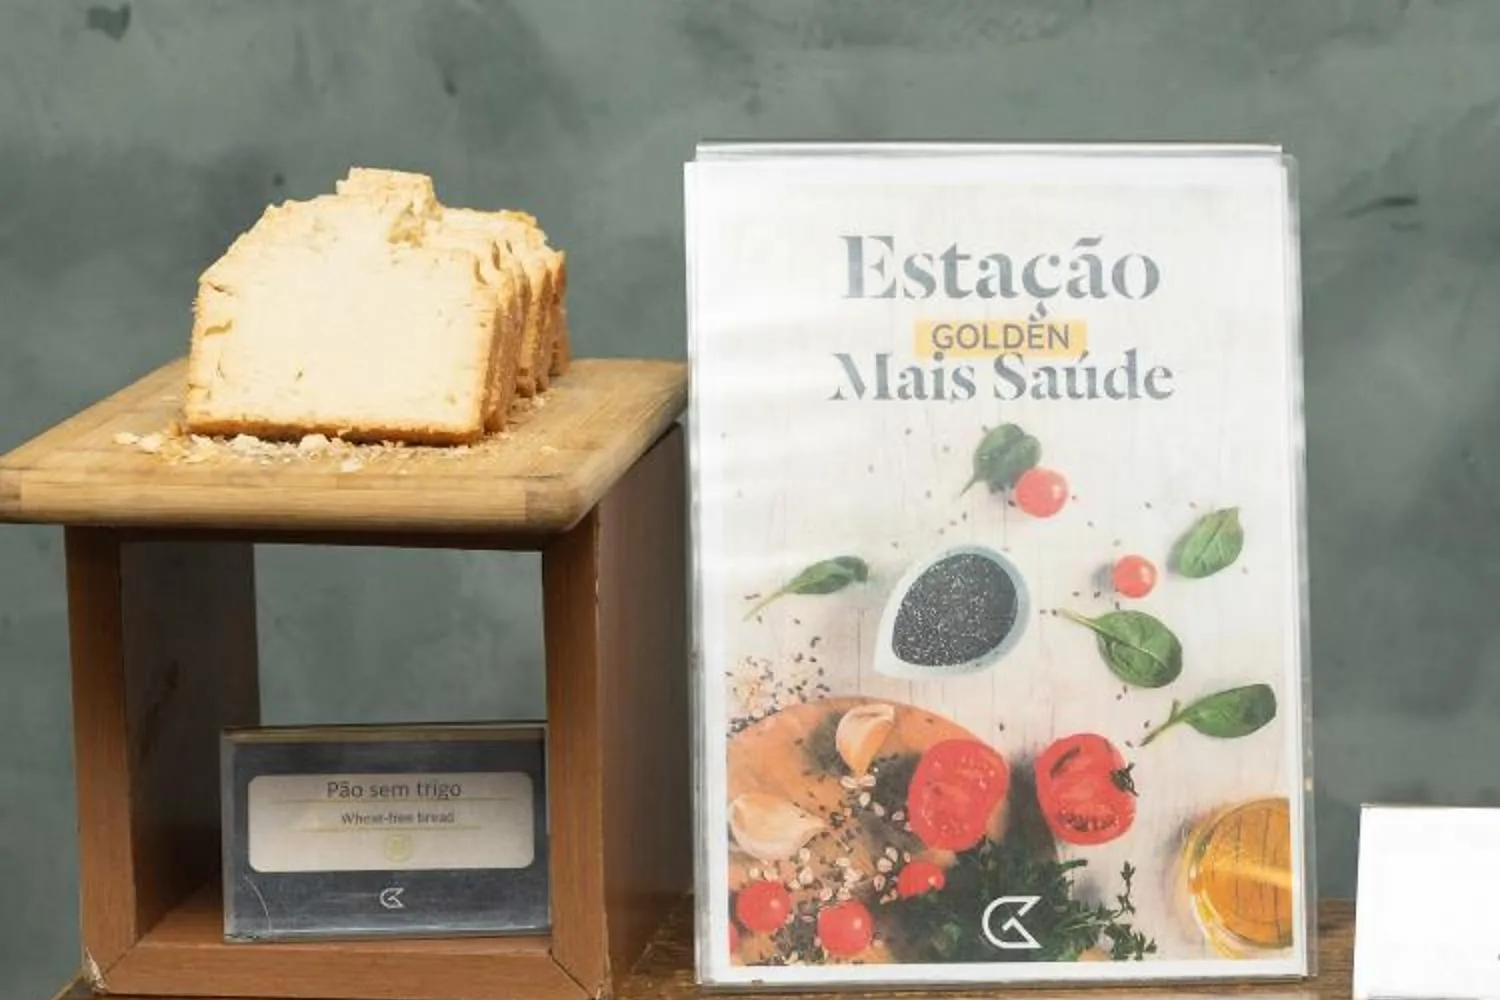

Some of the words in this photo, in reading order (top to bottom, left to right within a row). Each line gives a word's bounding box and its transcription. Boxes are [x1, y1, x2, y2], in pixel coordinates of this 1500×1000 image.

[839, 234, 1160, 322] Estação
[931, 324, 1070, 351] GOLDEN
[828, 351, 977, 400] Mais
[993, 347, 1175, 400] Saúde
[327, 780, 363, 798] Pão
[370, 782, 410, 798] sem
[416, 780, 462, 801] trigo
[341, 811, 413, 825] Wheat-free
[417, 810, 455, 824] bread
